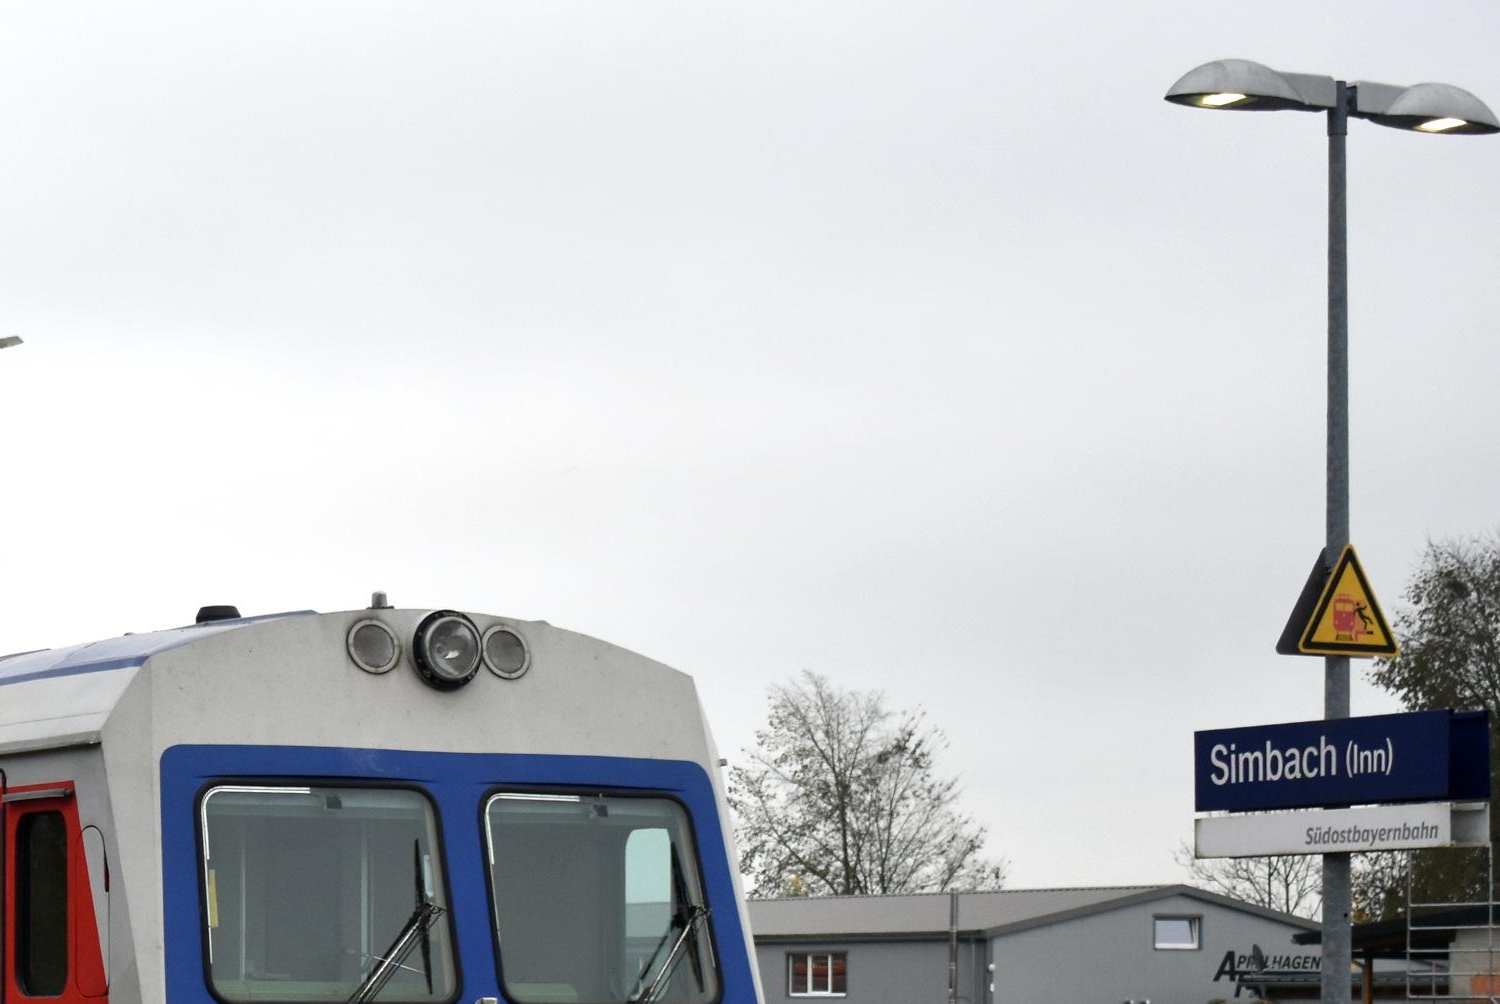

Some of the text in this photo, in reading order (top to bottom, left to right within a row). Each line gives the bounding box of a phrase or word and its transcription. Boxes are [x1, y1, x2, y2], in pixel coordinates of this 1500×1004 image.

[1210, 735, 1393, 786] Simbach (Inn)
[1305, 821, 1439, 847] Südostbayernbahn
